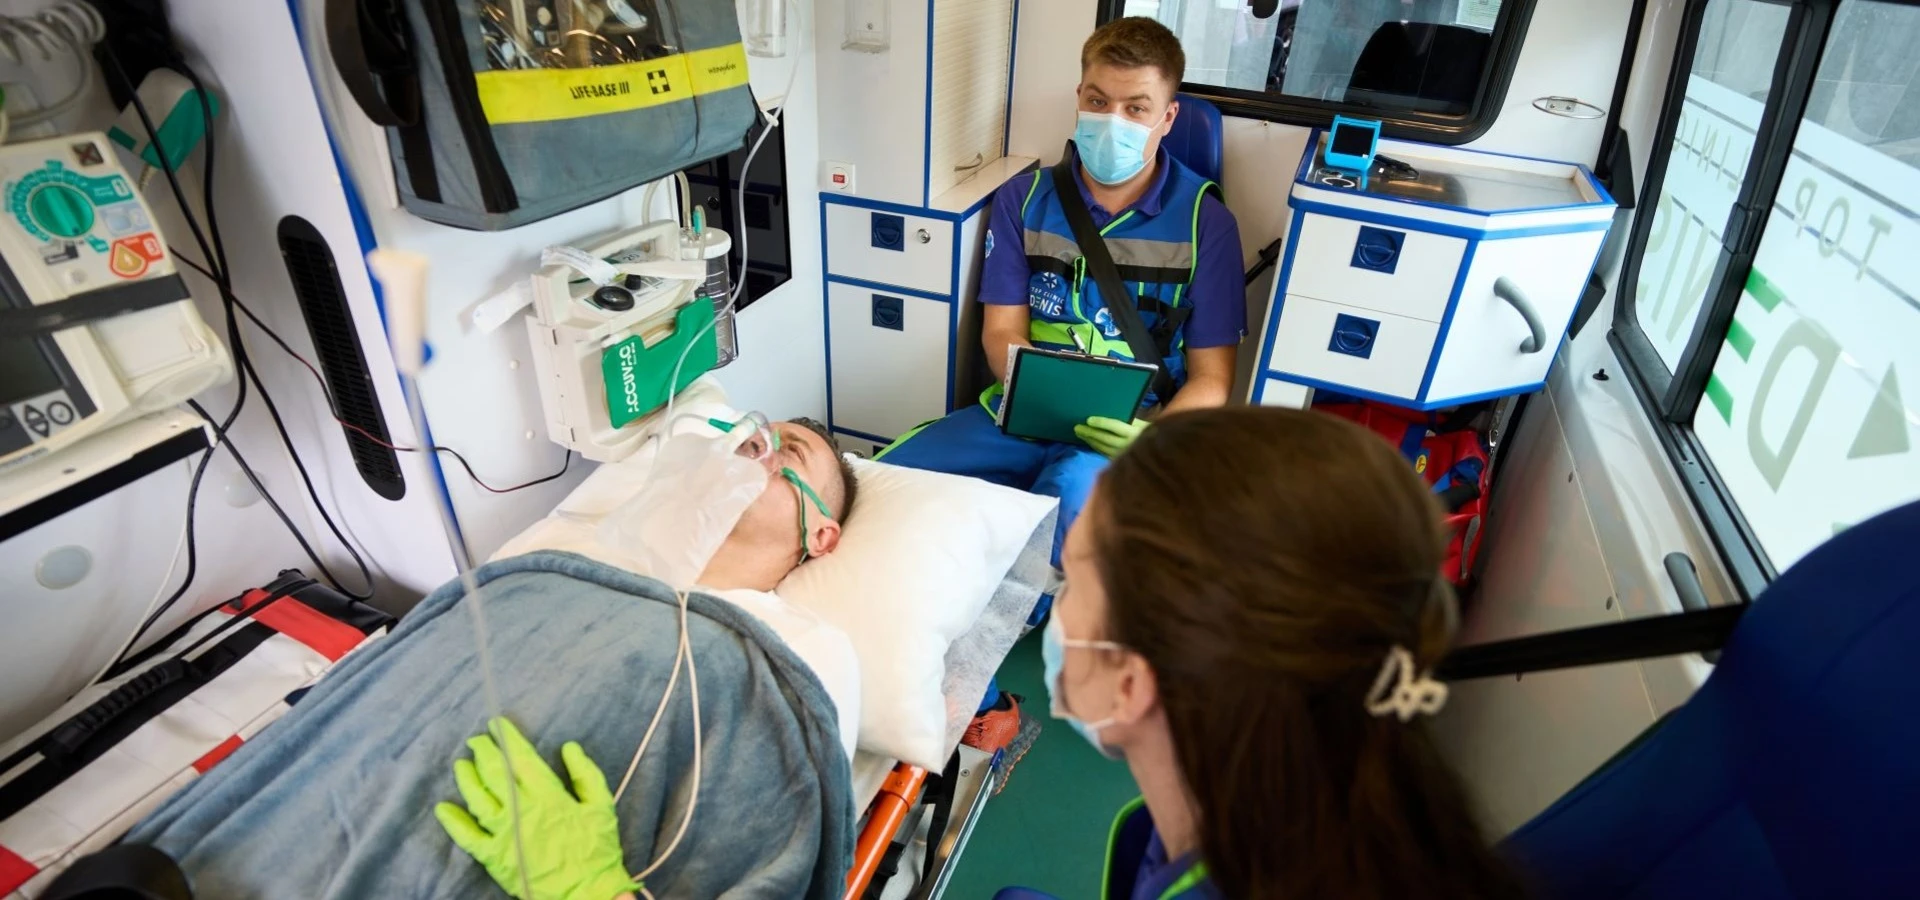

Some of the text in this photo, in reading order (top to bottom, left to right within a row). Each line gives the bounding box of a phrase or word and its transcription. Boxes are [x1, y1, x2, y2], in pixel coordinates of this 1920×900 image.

[569, 81, 630, 99] LIFE-BASE III
[1029, 294, 1062, 316] DENIS
[1031, 286, 1065, 304] TOP CLINIC
[618, 344, 640, 413] ACCUVAC
